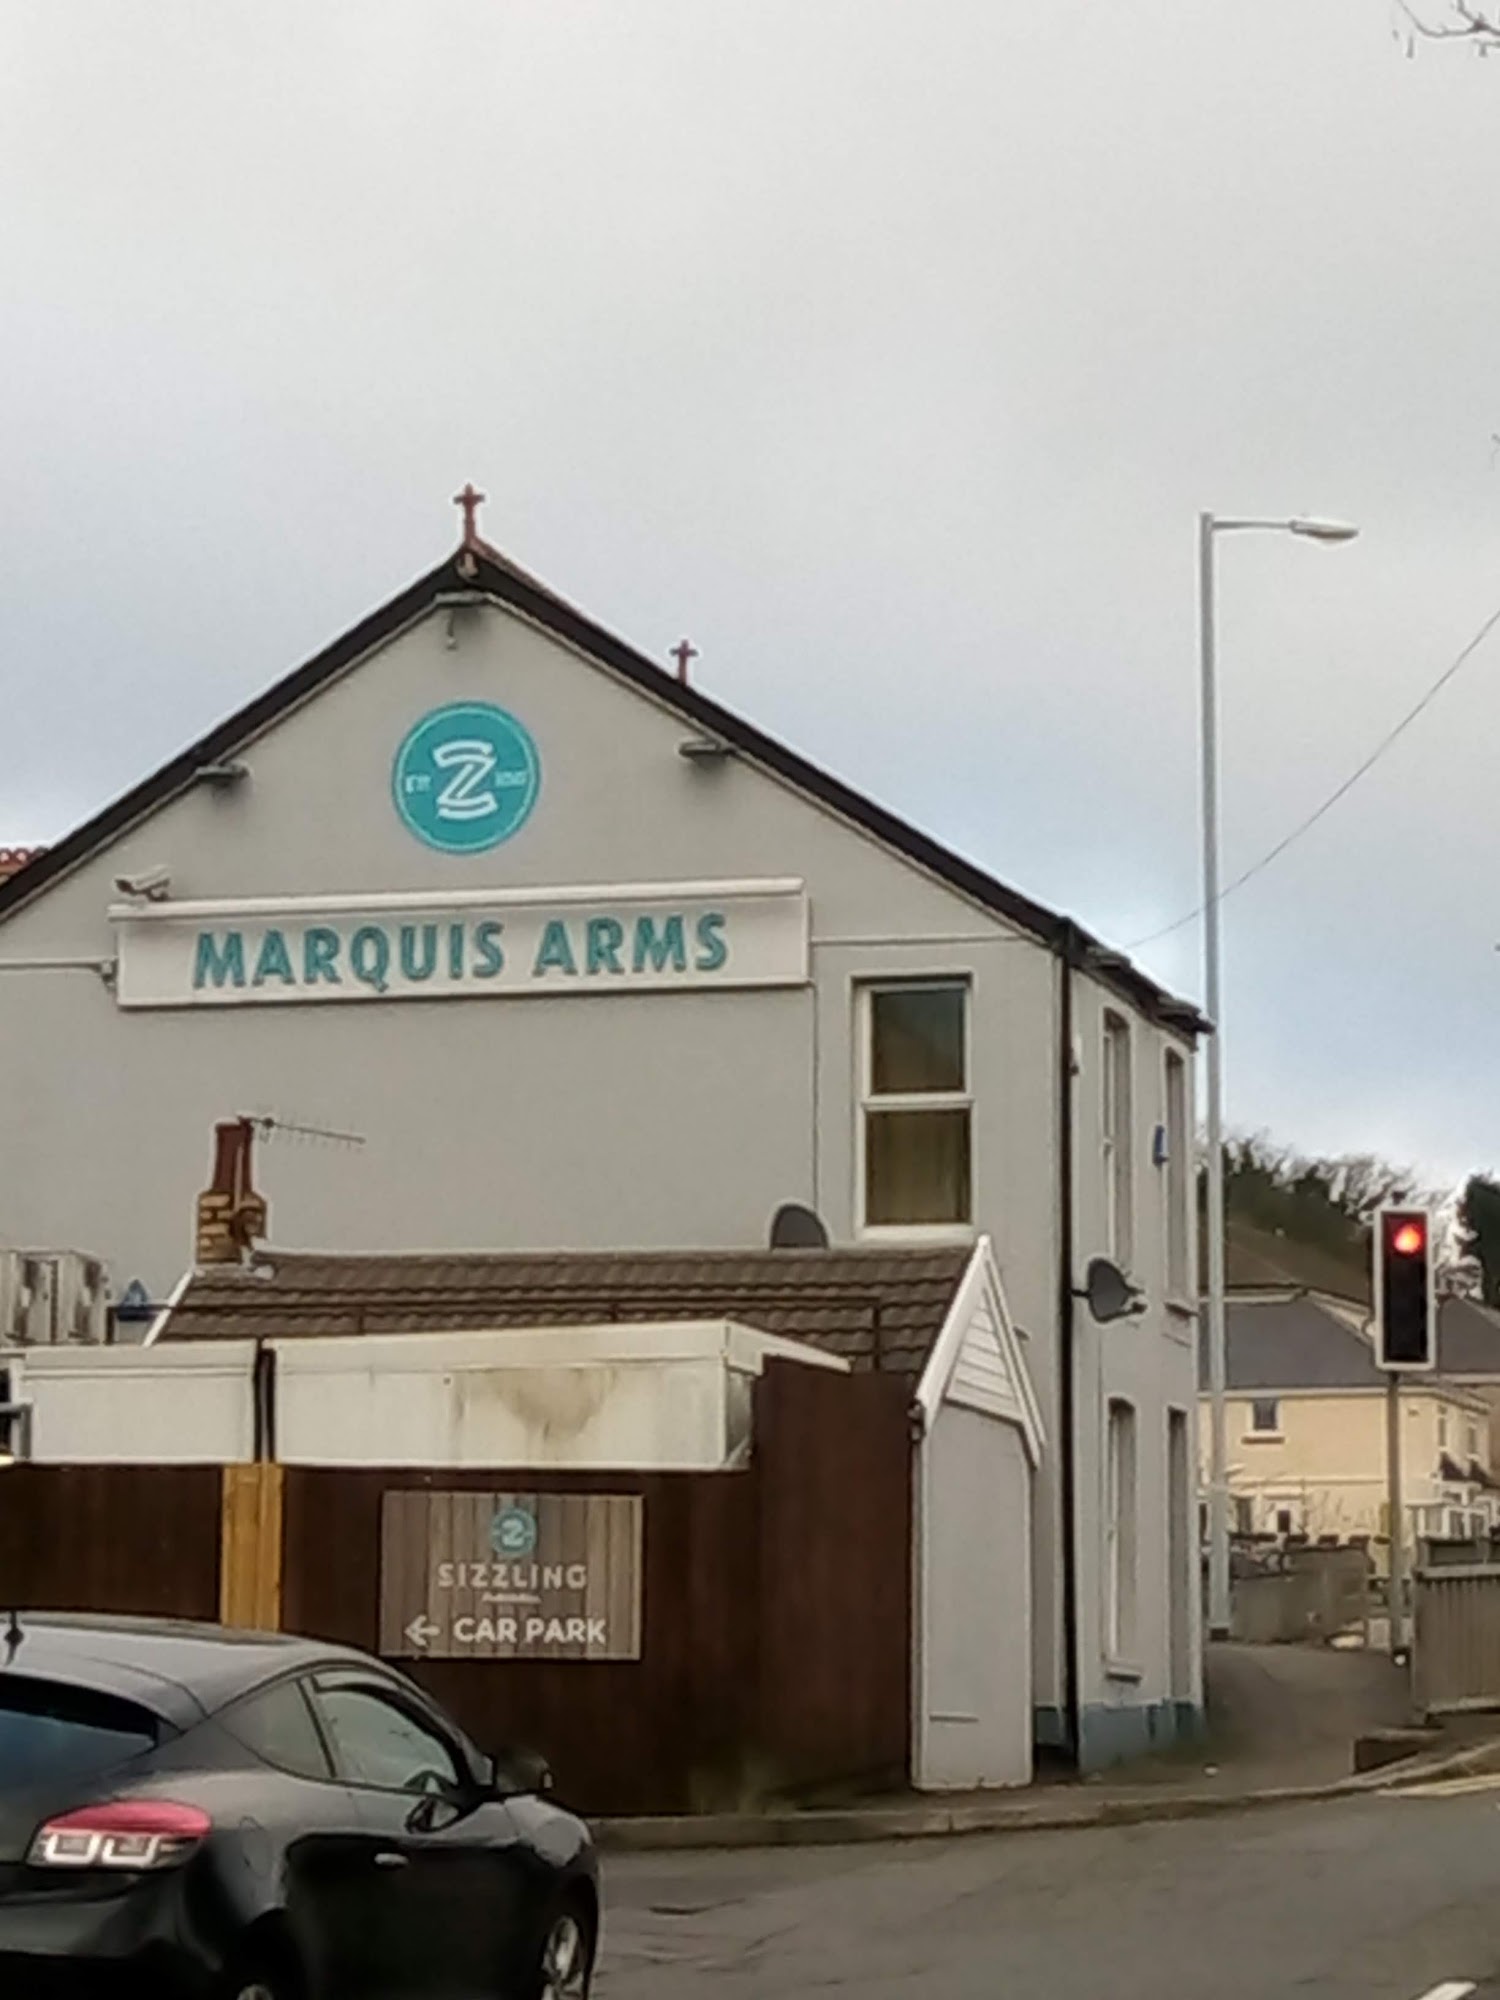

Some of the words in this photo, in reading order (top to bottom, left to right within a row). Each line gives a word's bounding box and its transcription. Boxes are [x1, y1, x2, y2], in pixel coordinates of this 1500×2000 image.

[193, 920, 504, 993] MARQUIS
[532, 912, 728, 976] ARMS
[437, 1563, 588, 1590] SIZZLING
[452, 1617, 517, 1644] CAR
[525, 1617, 607, 1646] PARK
